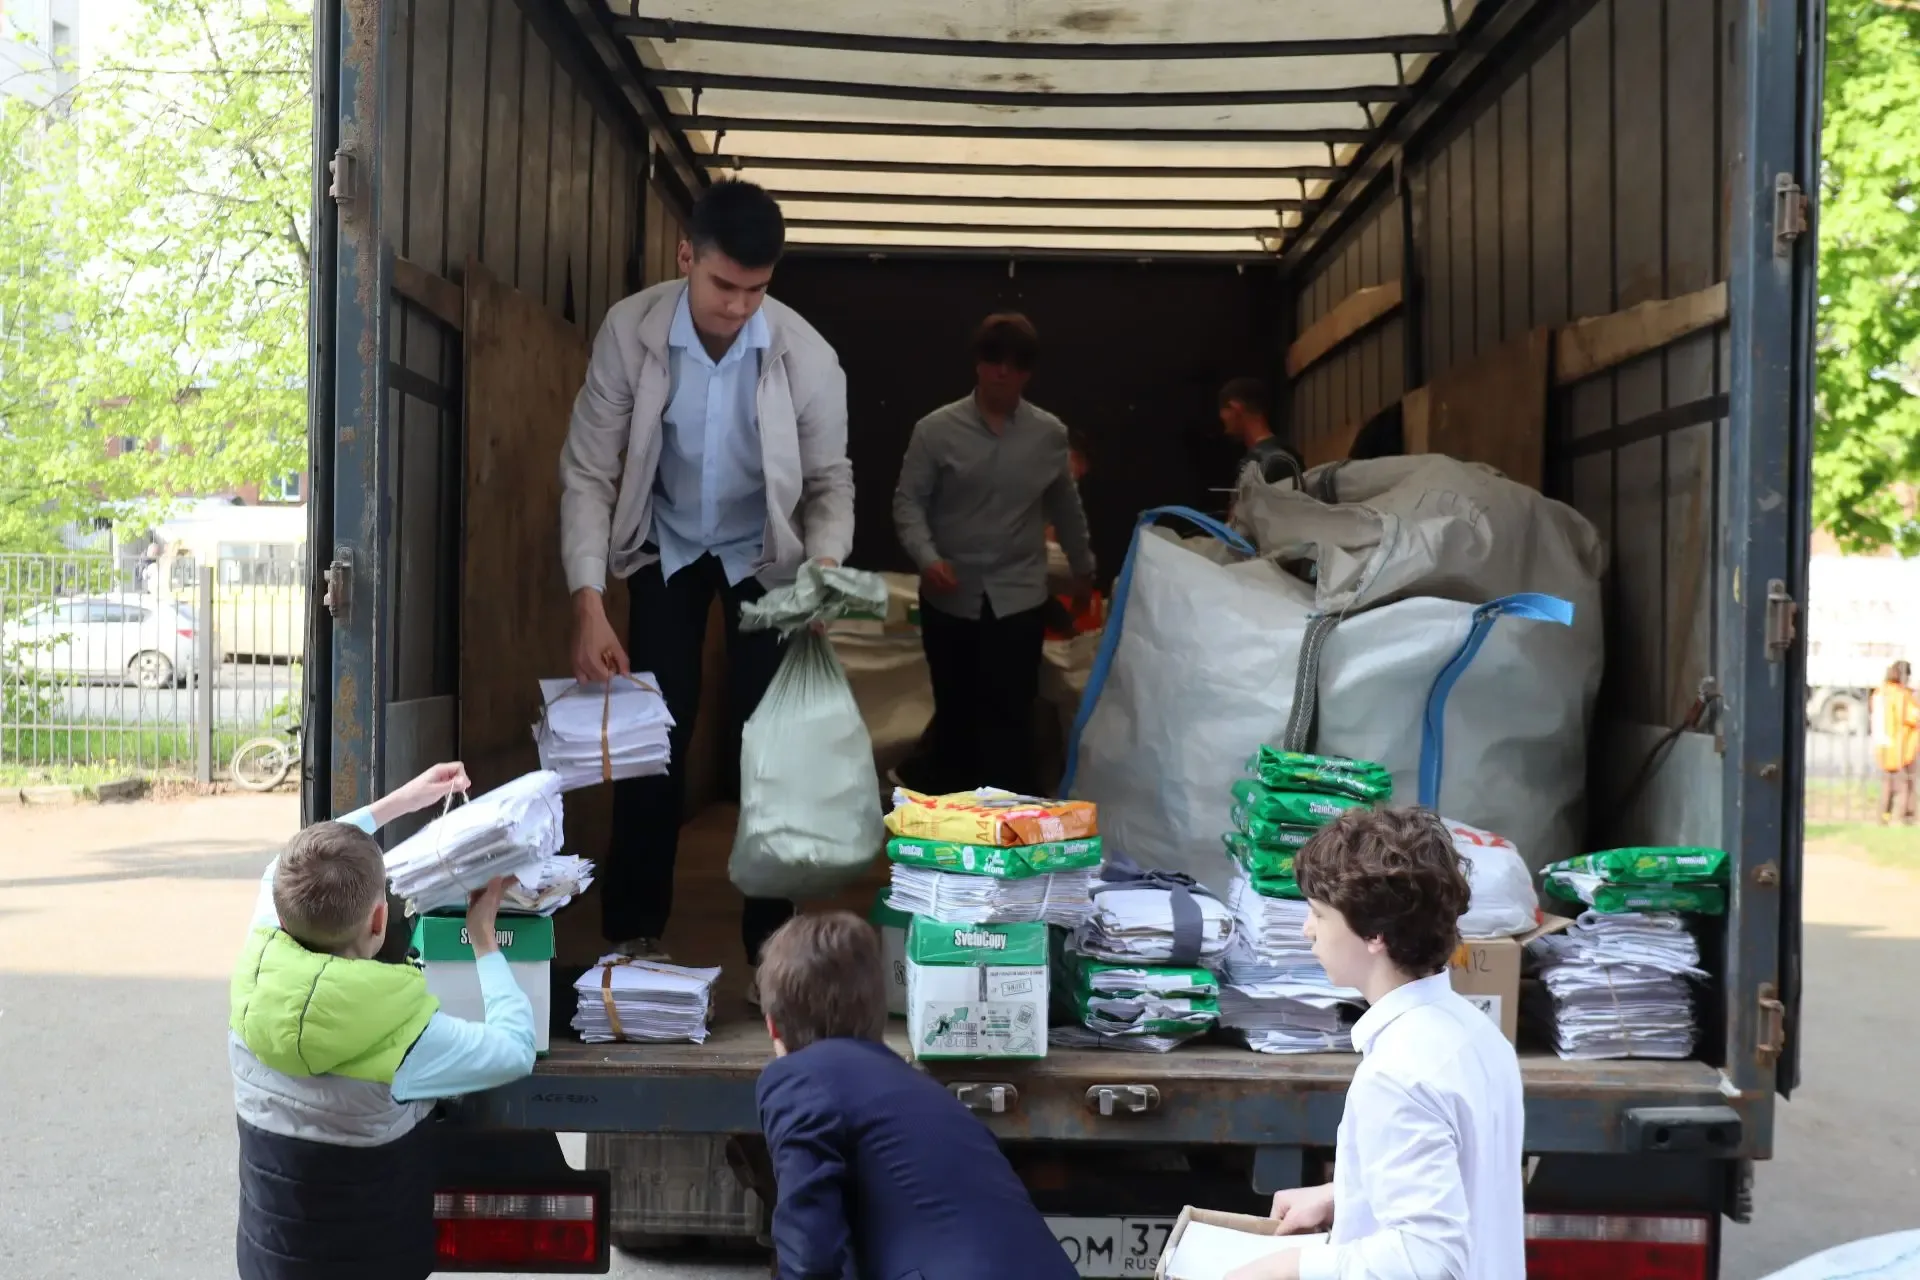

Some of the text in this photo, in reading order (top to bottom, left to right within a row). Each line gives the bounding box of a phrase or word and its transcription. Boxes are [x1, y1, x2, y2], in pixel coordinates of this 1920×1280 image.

[976, 820, 991, 843] A4
[954, 929, 1007, 950] SvetoCopy
[1131, 1224, 1173, 1256] 37
[1124, 1258, 1158, 1270] RUS
